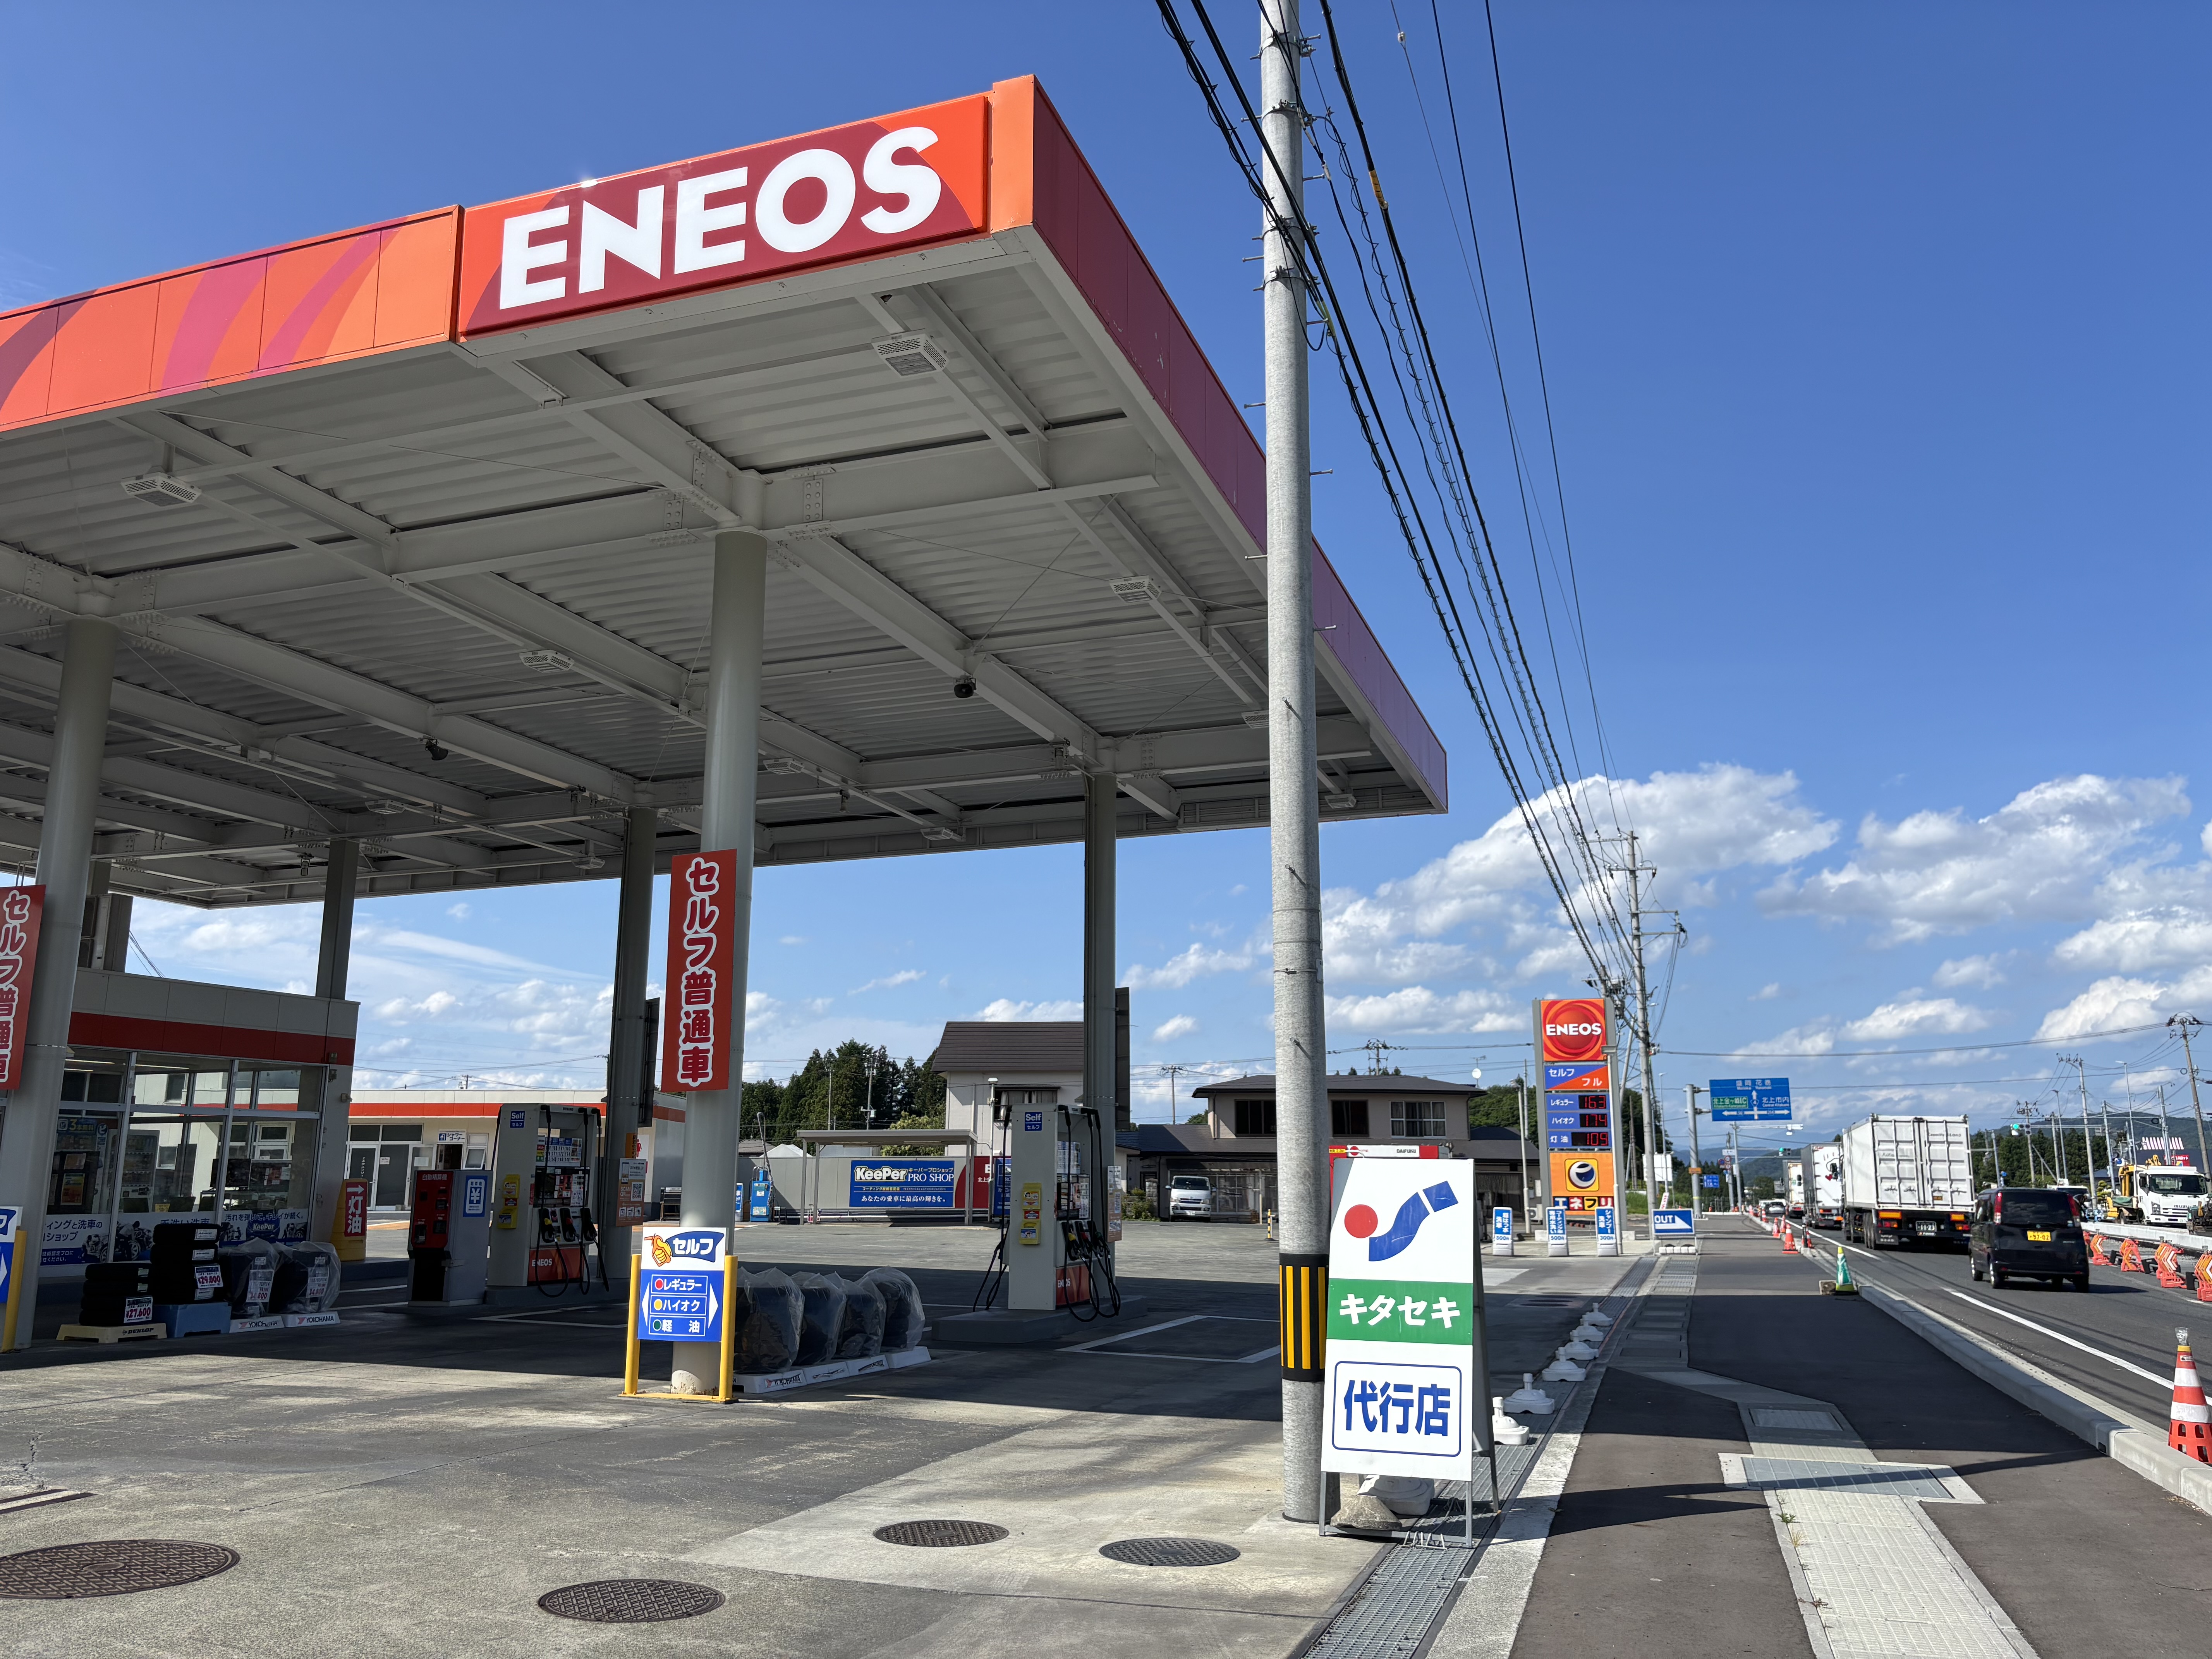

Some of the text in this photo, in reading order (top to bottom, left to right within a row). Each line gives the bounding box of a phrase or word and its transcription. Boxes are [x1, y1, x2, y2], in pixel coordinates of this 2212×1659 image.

[500, 127, 942, 310] ENEOS
[678, 857, 720, 1086] セルフ普通車
[1546, 1023, 1602, 1036] ENEOS
[1548, 1068, 1575, 1077] セルフ
[1582, 1077, 1602, 1087] フル
[1584, 1096, 1606, 1109] 163
[1585, 1114, 1607, 1127] 174
[1587, 1133, 1608, 1146] 109
[855, 1166, 908, 1181] KeePer
[908, 1173, 954, 1182] PRO SHOP
[1555, 1197, 1612, 1210] エネフリ
[225, 1211, 303, 1221] 汚れを弾いて、キレイが続く。
[348, 1196, 363, 1233] 灯油
[1654, 1215, 1673, 1223] OUT
[45, 1219, 103, 1229] ィングと洗車の
[1496, 1216, 1502, 1228] 洗車
[1599, 1216, 1605, 1228] 洗車
[43, 1232, 78, 1242] ショップ
[673, 1238, 714, 1255] セルフ
[664, 1279, 702, 1291] レギュラー
[666, 1299, 700, 1312] ハイオク
[1340, 1293, 1460, 1328] キタセキ
[1343, 1379, 1450, 1436] 代行店
